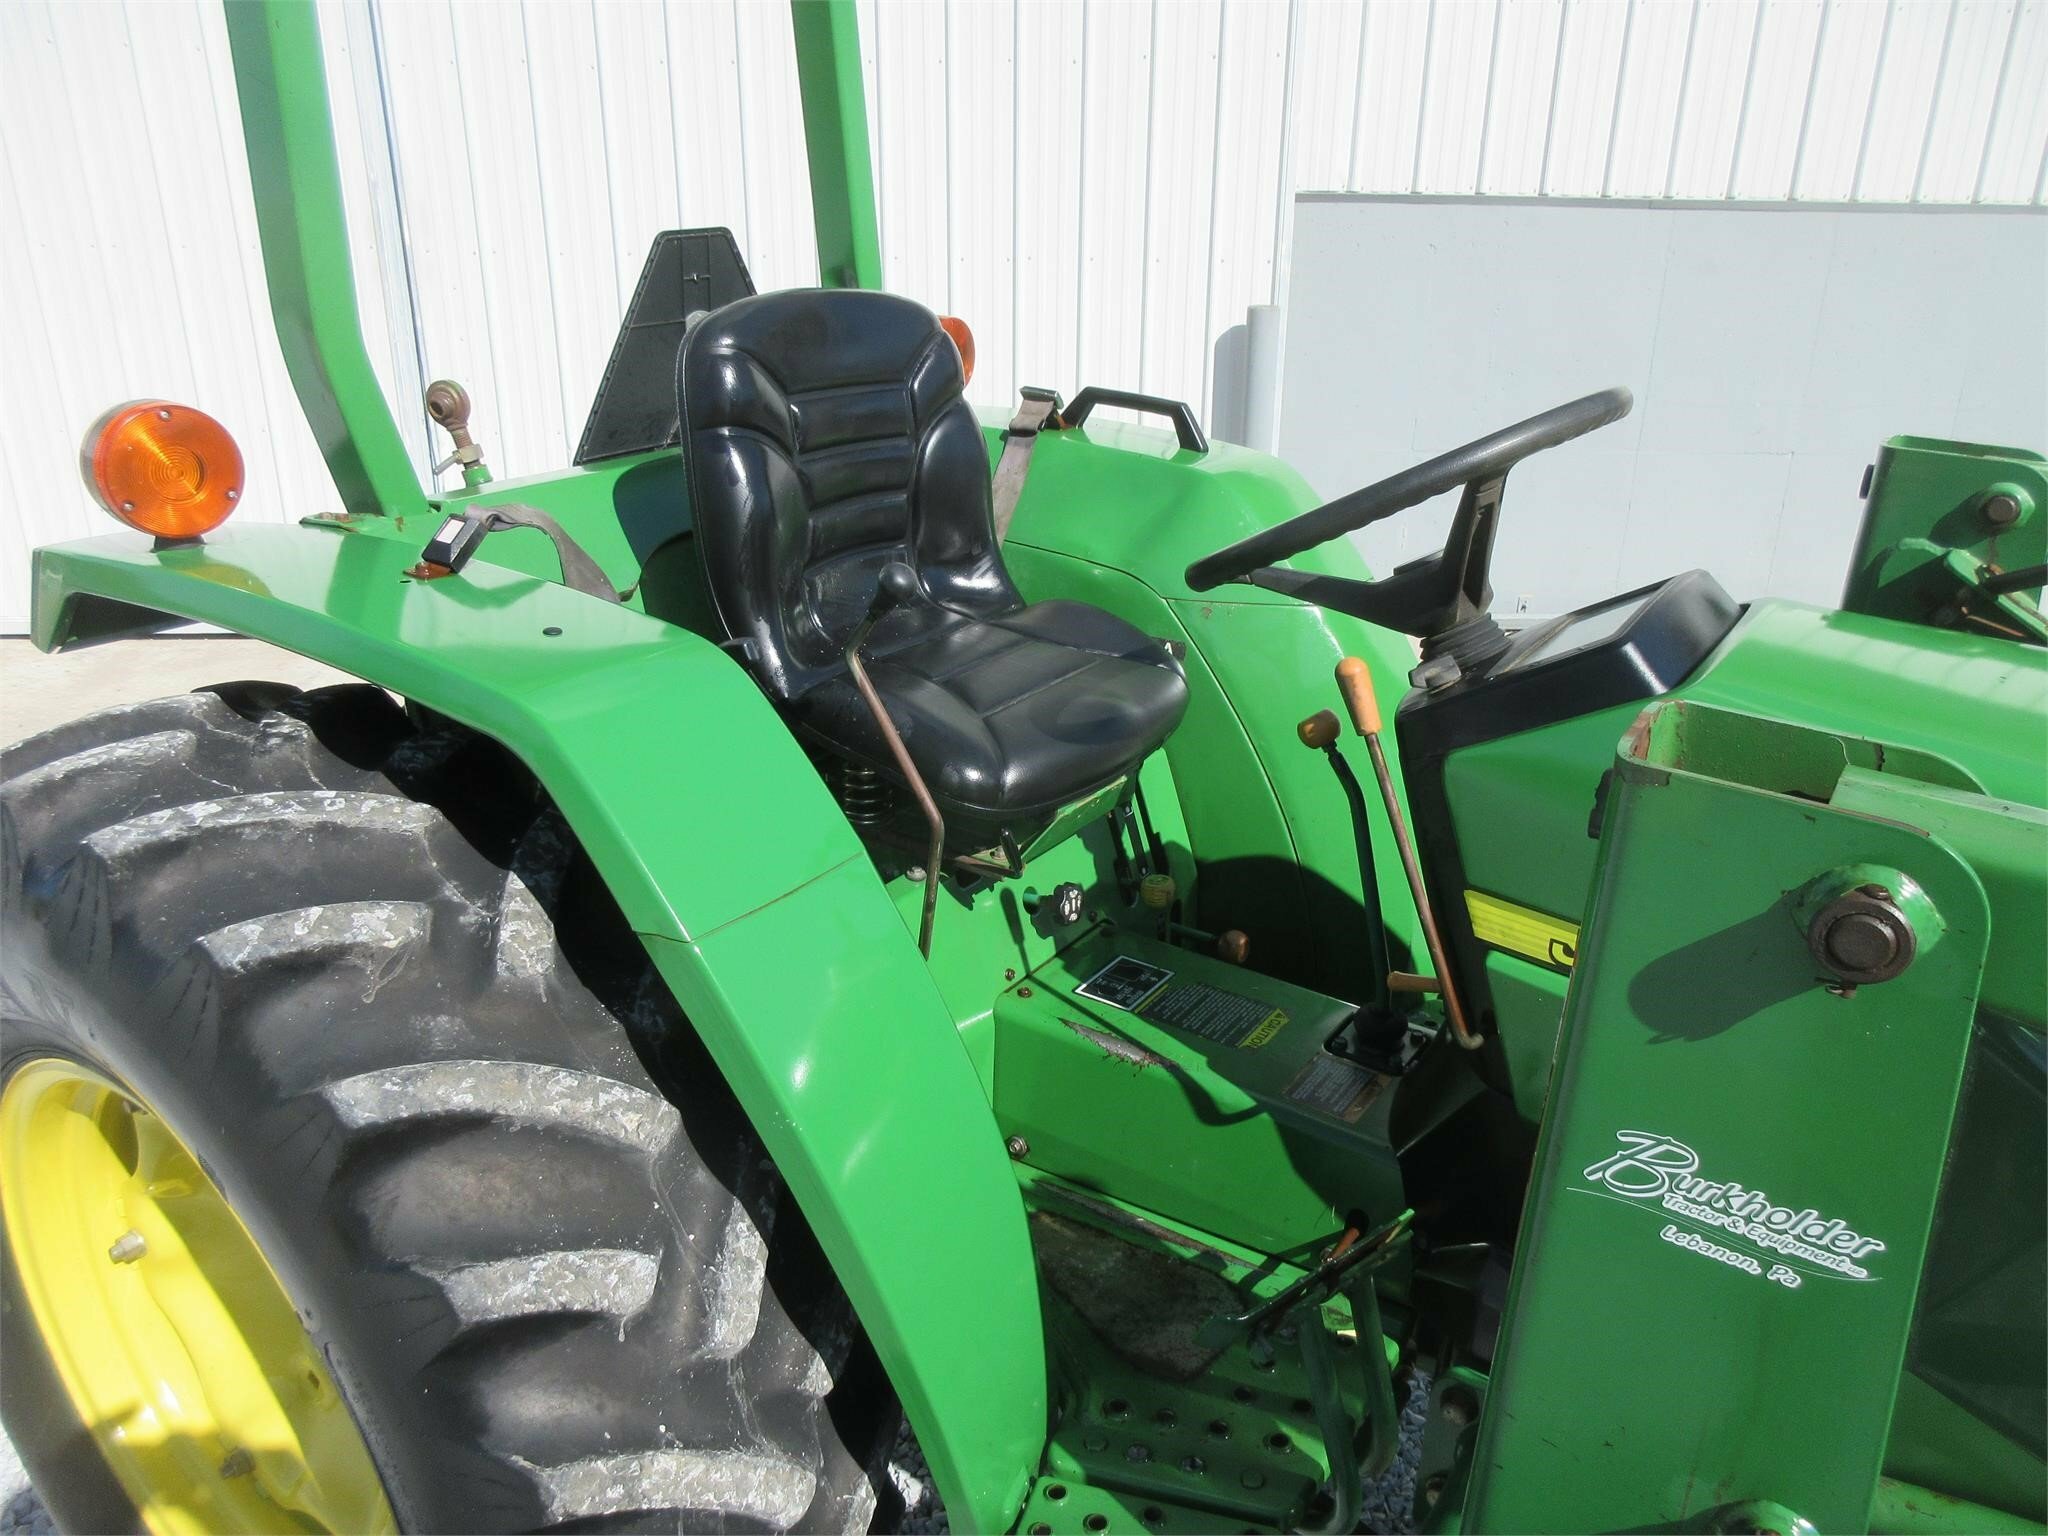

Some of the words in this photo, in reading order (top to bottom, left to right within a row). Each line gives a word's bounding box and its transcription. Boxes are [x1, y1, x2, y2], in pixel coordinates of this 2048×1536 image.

[1584, 1130, 1885, 1257] Burkholder
[1662, 1193, 1727, 1225] Tractor
[1725, 1216, 1745, 1234] &
[1744, 1223, 1852, 1272] Equipment
[1766, 1265, 1801, 1288] Pa
